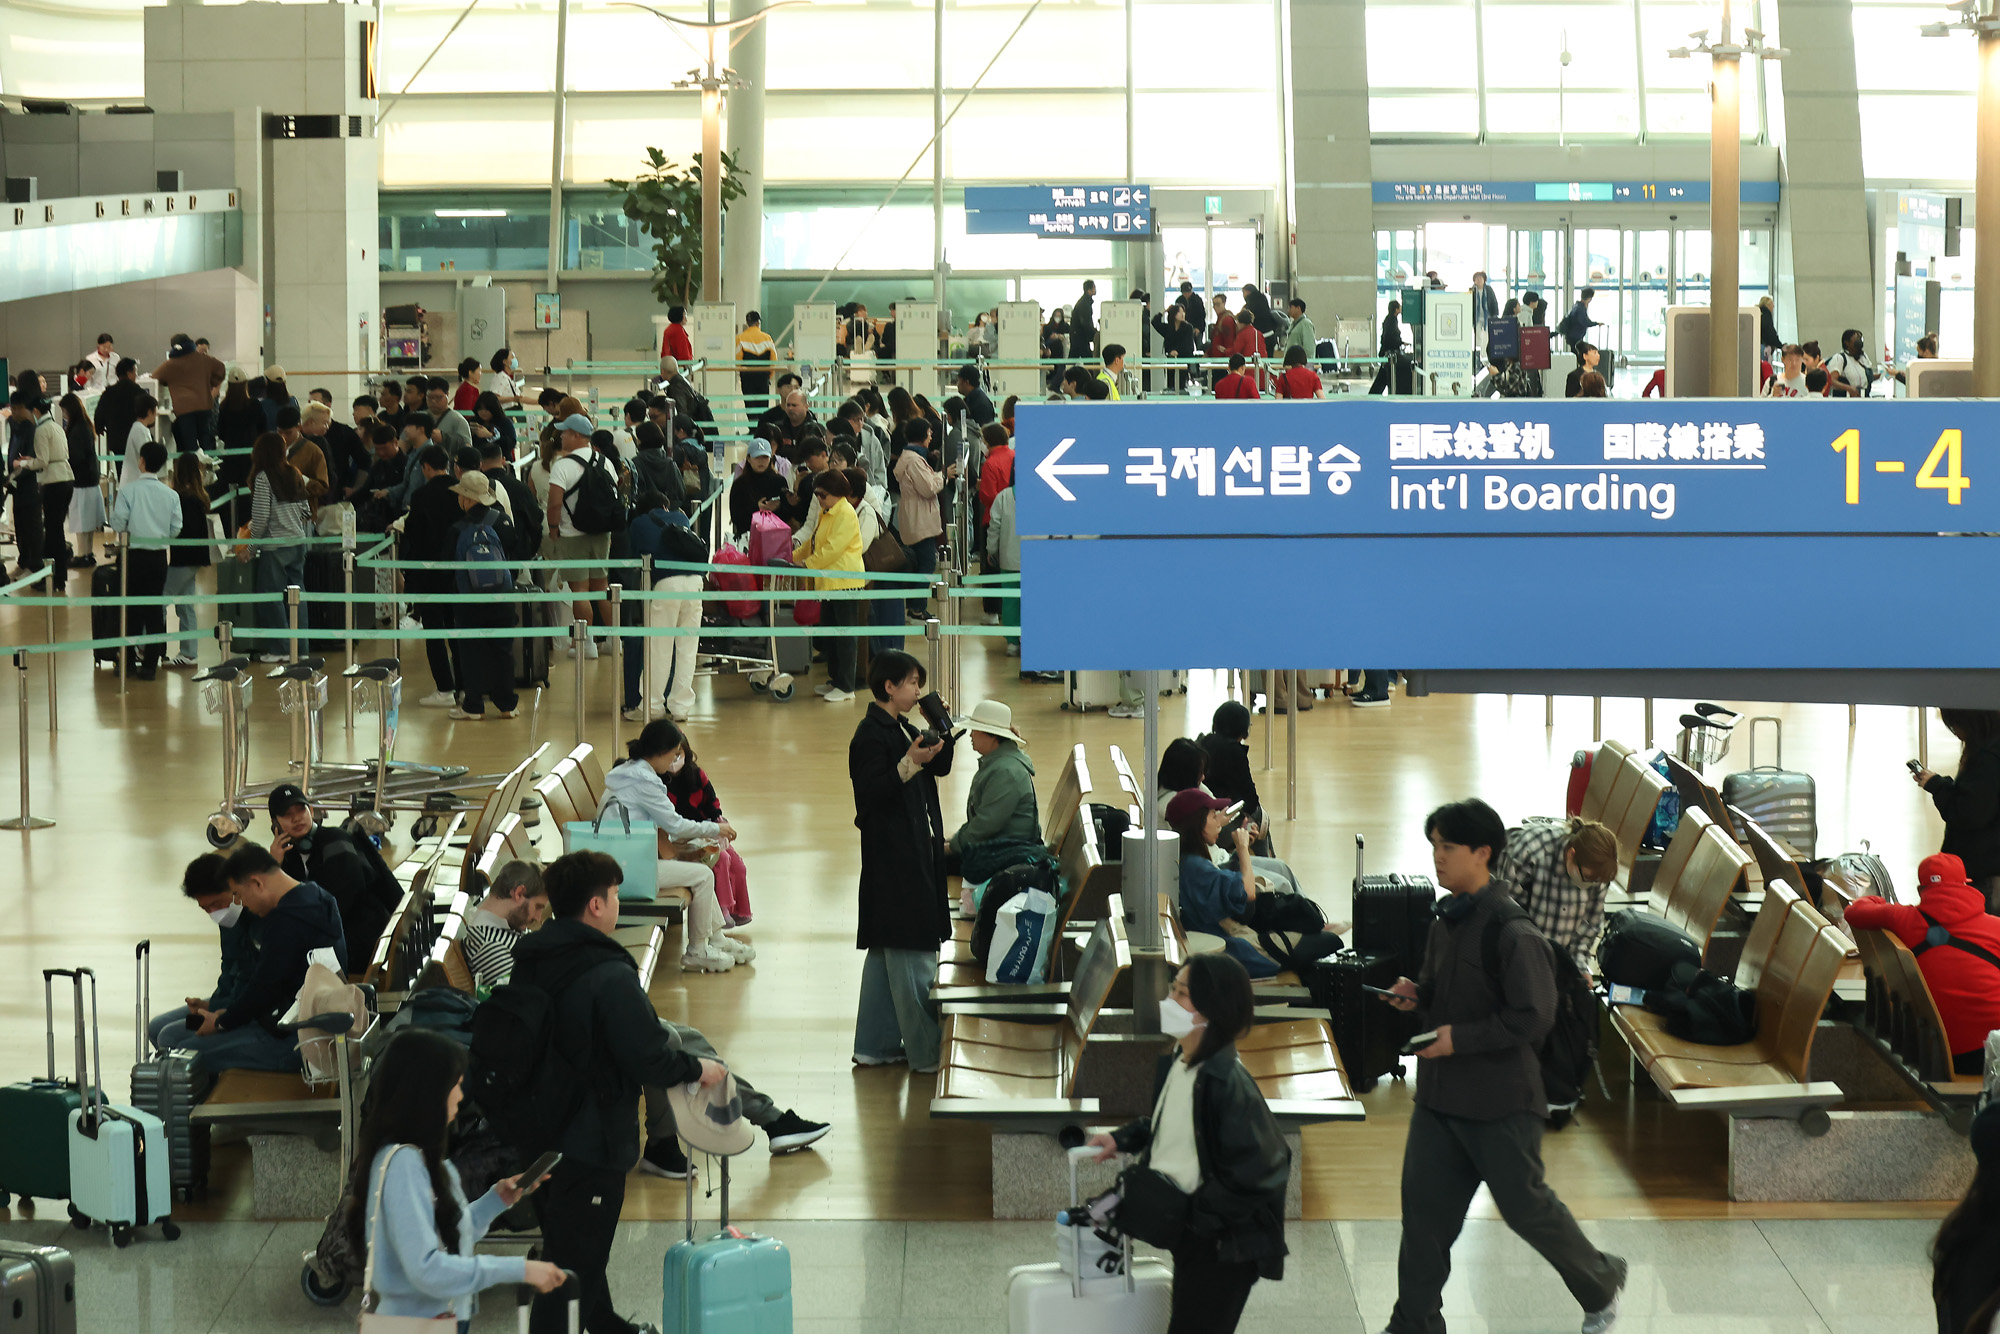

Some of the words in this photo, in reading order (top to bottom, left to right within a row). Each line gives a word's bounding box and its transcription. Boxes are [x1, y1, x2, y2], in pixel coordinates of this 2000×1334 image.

[366, 19, 379, 100] K
[1642, 184, 1656, 199] 11
[1389, 421, 1555, 460] 国际线登机
[1125, 443, 1362, 497] 국제선탑승
[1831, 429, 1971, 505] 1-4
[1390, 473, 1468, 510] Int'l
[1484, 473, 1676, 520] Boarding
[1016, 946, 1028, 965] DUTY
